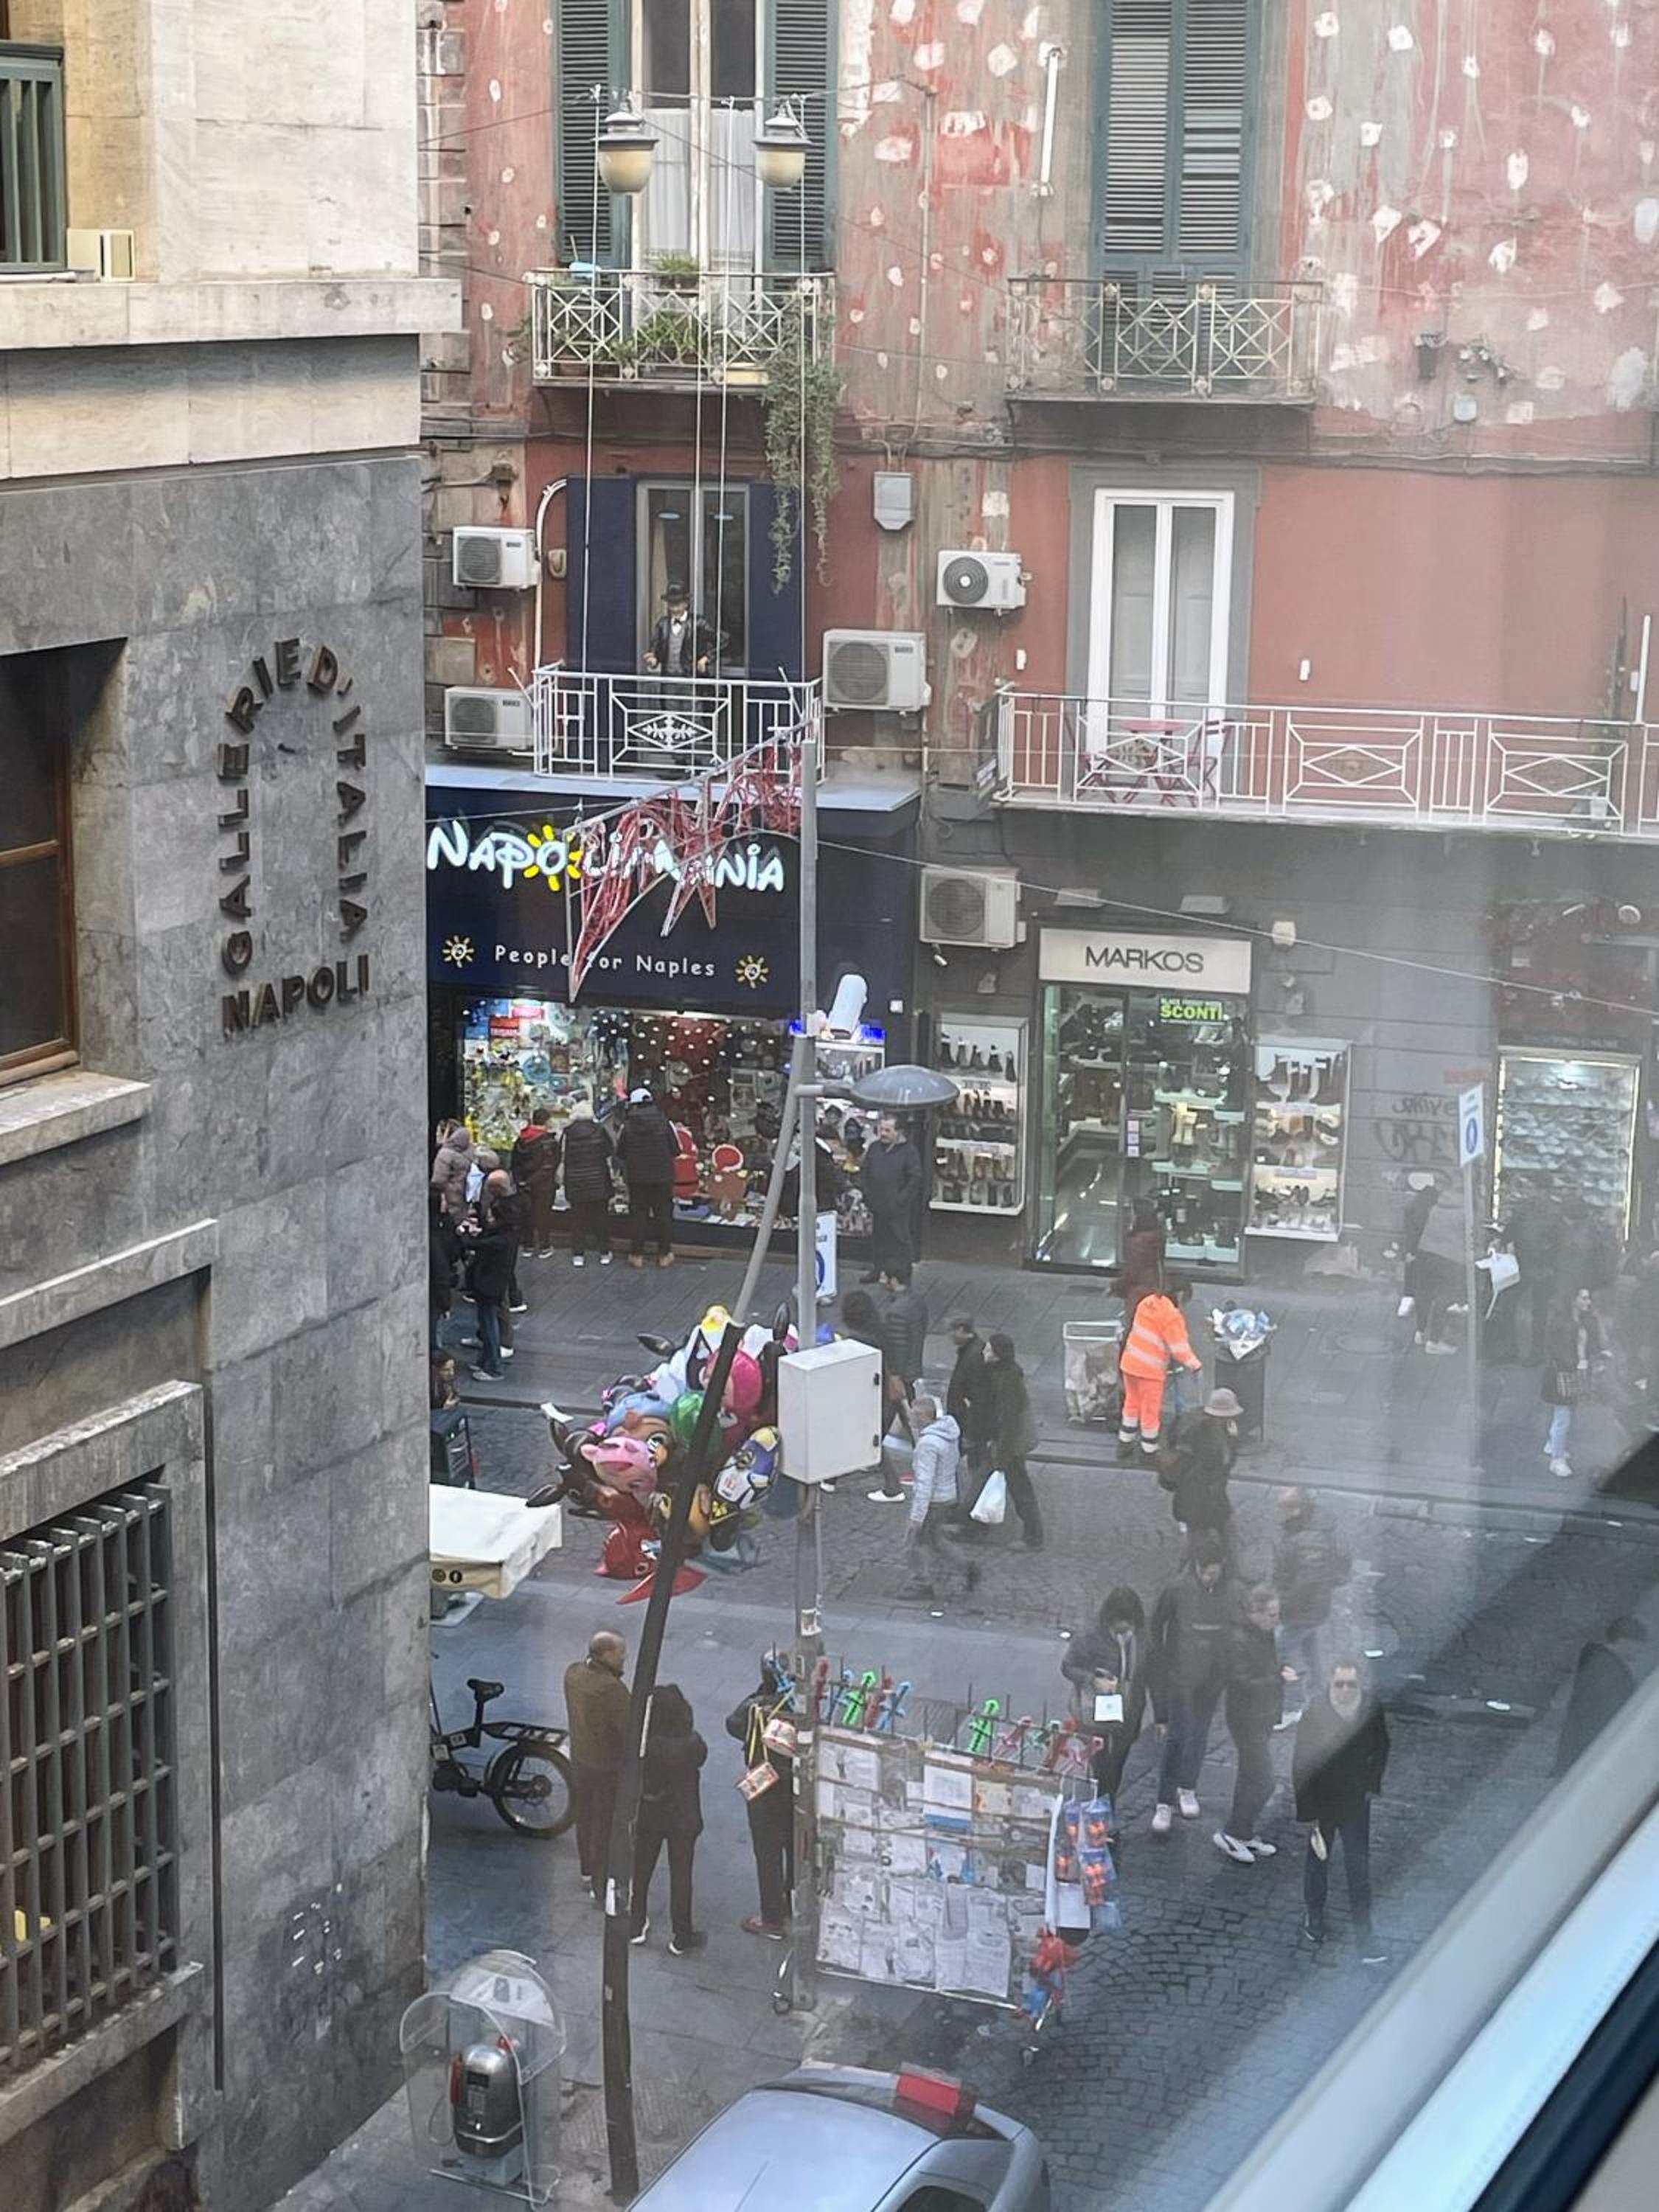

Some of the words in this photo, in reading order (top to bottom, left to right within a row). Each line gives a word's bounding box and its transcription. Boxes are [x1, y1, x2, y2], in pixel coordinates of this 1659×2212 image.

[218, 637, 302, 976] GALLERIE
[306, 645, 369, 944] D'ITALIA
[495, 945, 573, 970] People
[636, 955, 715, 978] Naples
[1085, 946, 1204, 973] MARKOS
[223, 953, 369, 1035] NAPOLI
[1160, 1004, 1222, 1021] SCONTI
